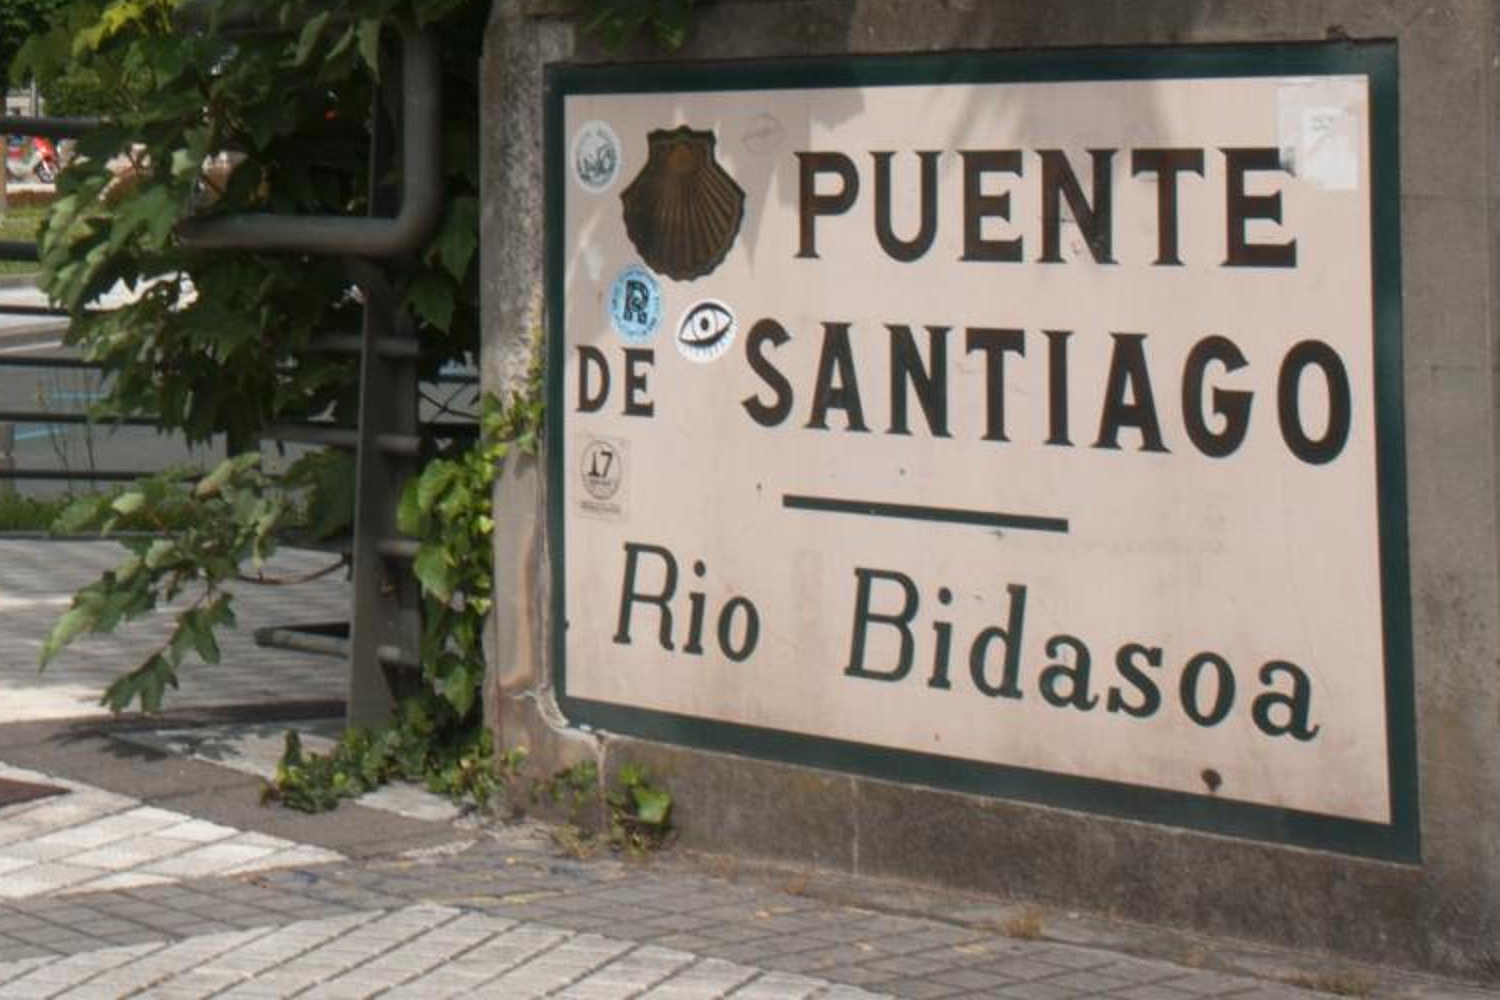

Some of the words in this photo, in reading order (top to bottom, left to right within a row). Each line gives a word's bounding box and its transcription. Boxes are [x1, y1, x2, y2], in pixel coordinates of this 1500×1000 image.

[793, 147, 1298, 268] PUENTE
[574, 344, 656, 418] DE
[742, 317, 1353, 466] SANTIAGO
[612, 542, 761, 664] Rio
[843, 567, 1320, 743] Bidasoa
